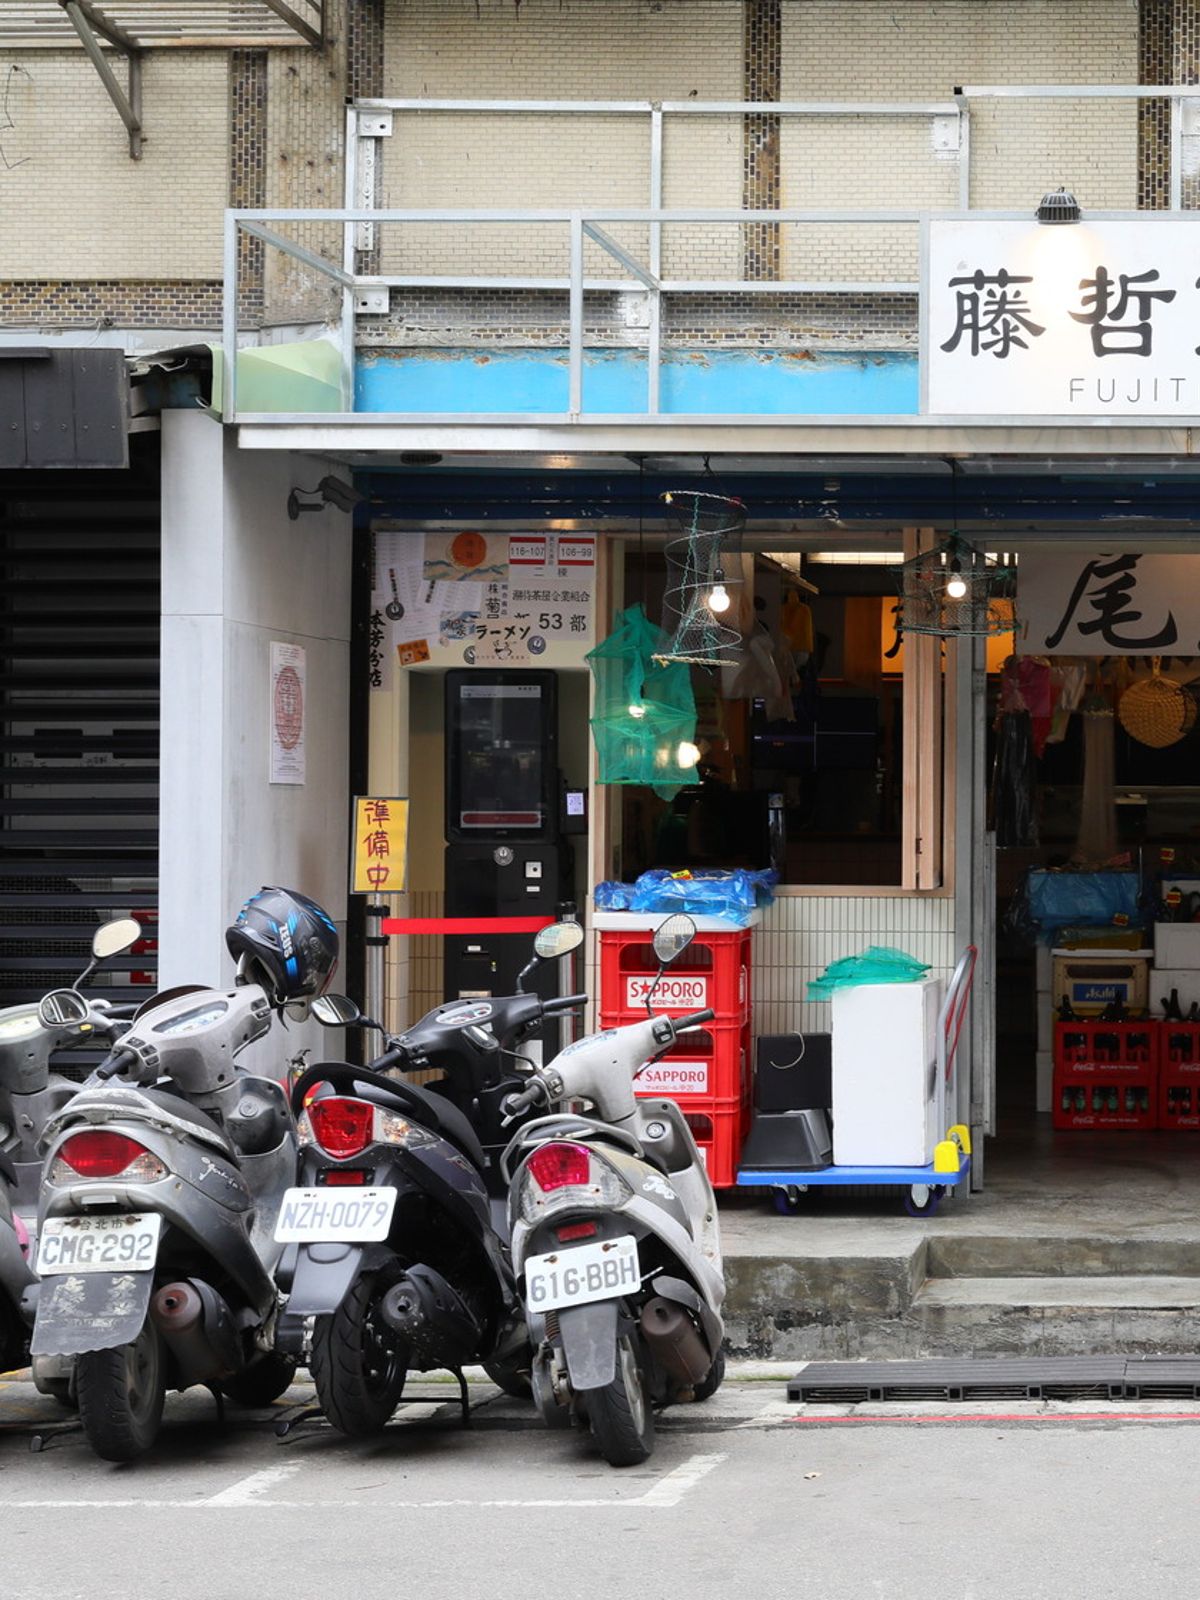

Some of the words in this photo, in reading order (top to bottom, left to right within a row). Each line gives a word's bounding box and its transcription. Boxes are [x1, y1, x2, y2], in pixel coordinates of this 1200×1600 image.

[539, 613, 563, 630] 53
[476, 625, 531, 640] ラーメン
[363, 800, 391, 891] 準備中
[645, 1070, 705, 1083] SAPPORO
[79, 1216, 124, 1231] 台北市
